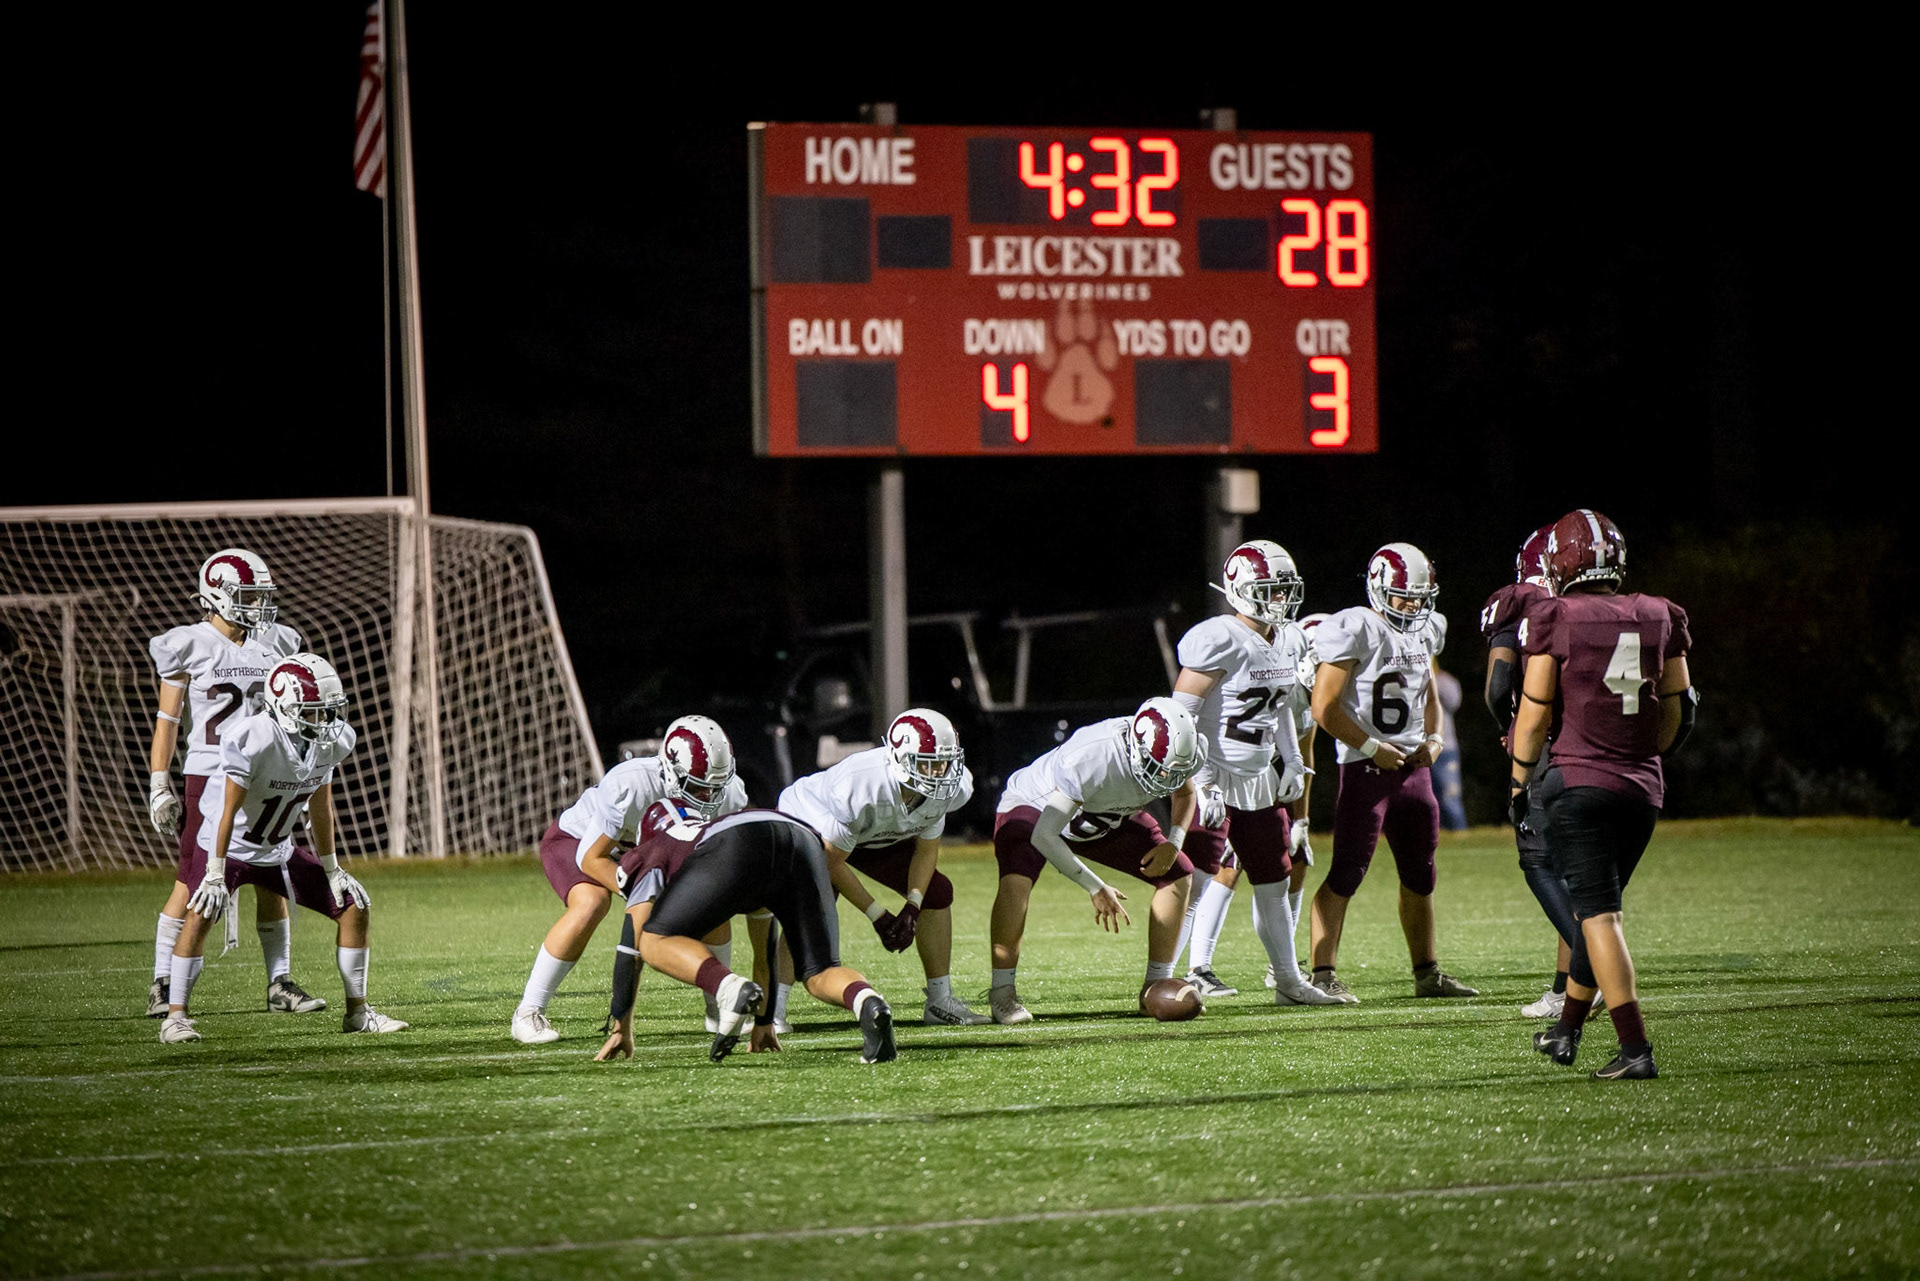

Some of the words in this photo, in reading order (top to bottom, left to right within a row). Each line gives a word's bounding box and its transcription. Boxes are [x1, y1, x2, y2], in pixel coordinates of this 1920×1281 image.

[805, 137, 916, 185] HOME
[1018, 137, 1179, 227] 4:32
[1210, 143, 1354, 191] GUESTS
[969, 235, 1184, 277] LEICESTER
[1277, 199, 1369, 287] 28
[997, 282, 1151, 301] WOLVERINES
[789, 318, 859, 355] BALL
[862, 318, 903, 355] ON
[964, 318, 1045, 355] DOWN
[1112, 319, 1167, 356] YDS
[1168, 319, 1206, 356] TO
[1209, 319, 1251, 356] GO
[1295, 319, 1351, 356] QTR
[982, 362, 1030, 442] 4
[1308, 356, 1350, 447] 3
[1517, 617, 1529, 647] 4
[214, 666, 270, 679] NORTHBRIDG
[1603, 632, 1648, 715] 4
